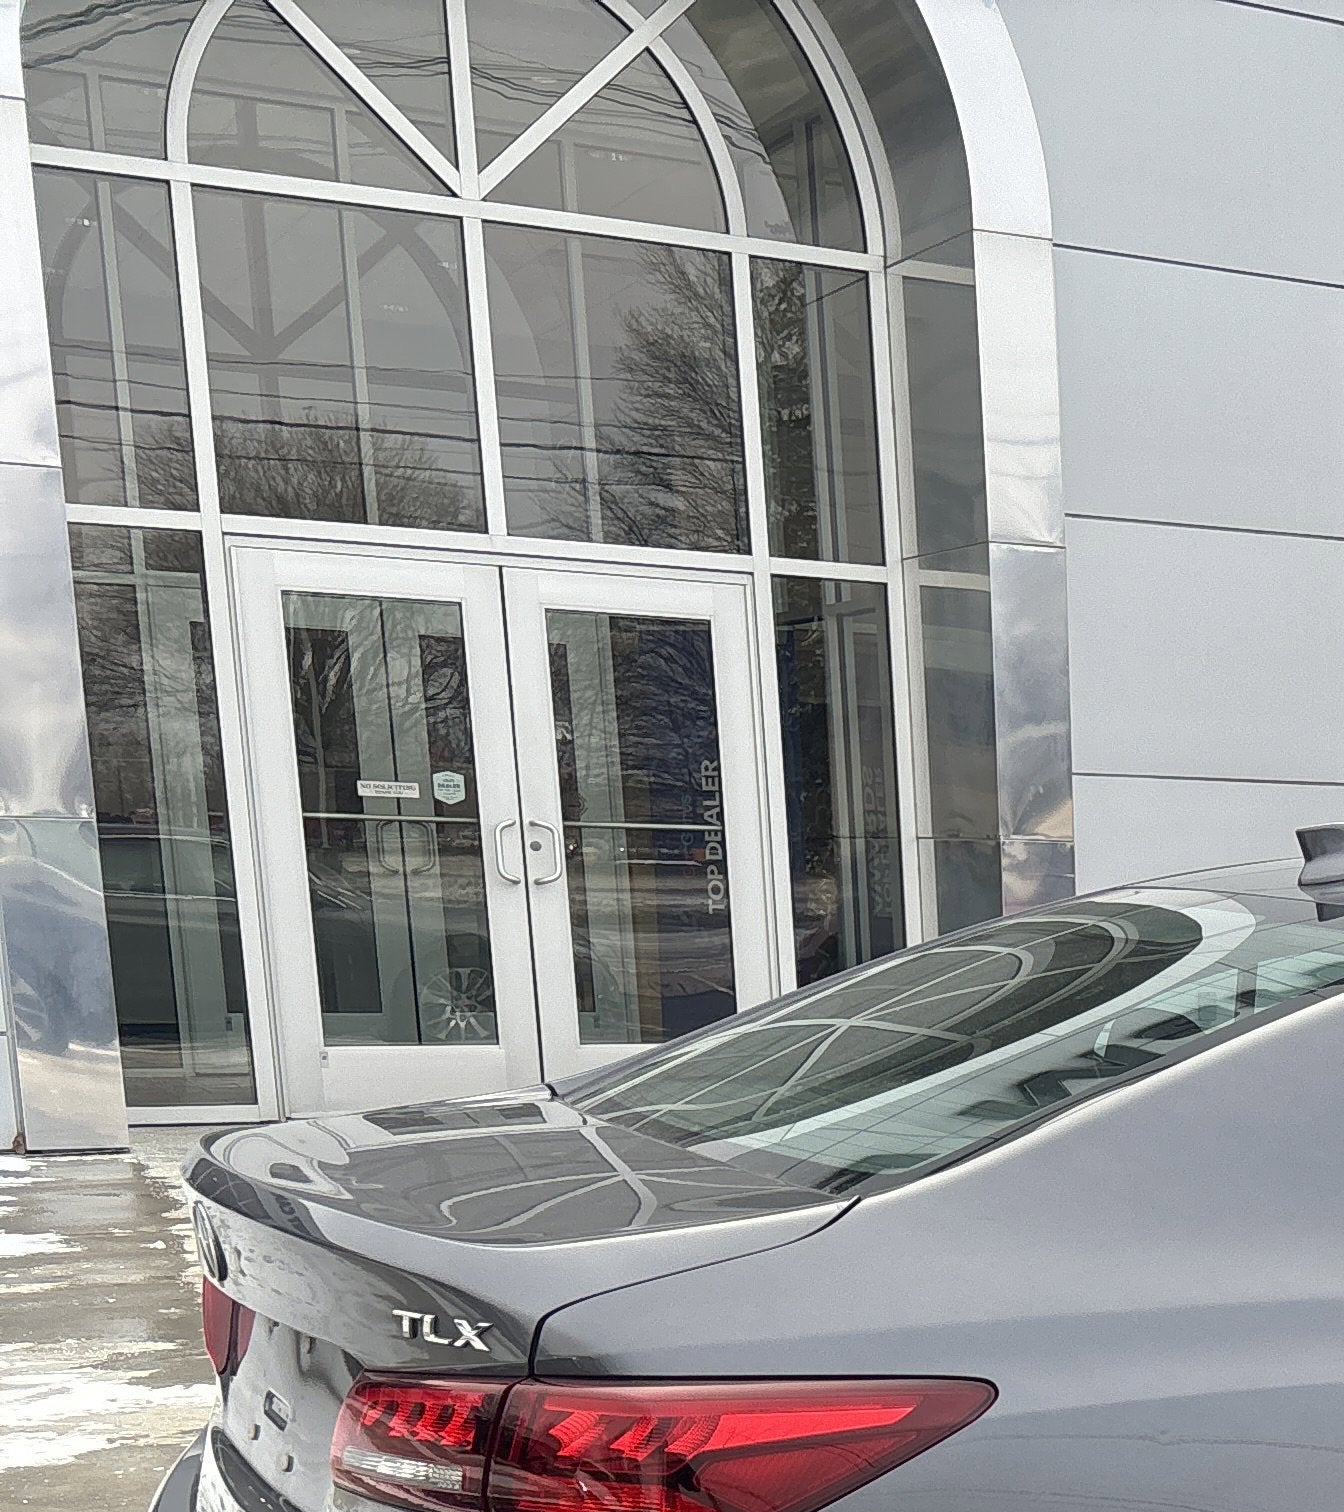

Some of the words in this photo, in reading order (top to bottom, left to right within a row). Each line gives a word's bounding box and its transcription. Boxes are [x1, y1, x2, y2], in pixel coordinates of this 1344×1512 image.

[701, 760, 722, 860] DEALER
[707, 864, 726, 914] TOP
[392, 1309, 494, 1352] TLX
